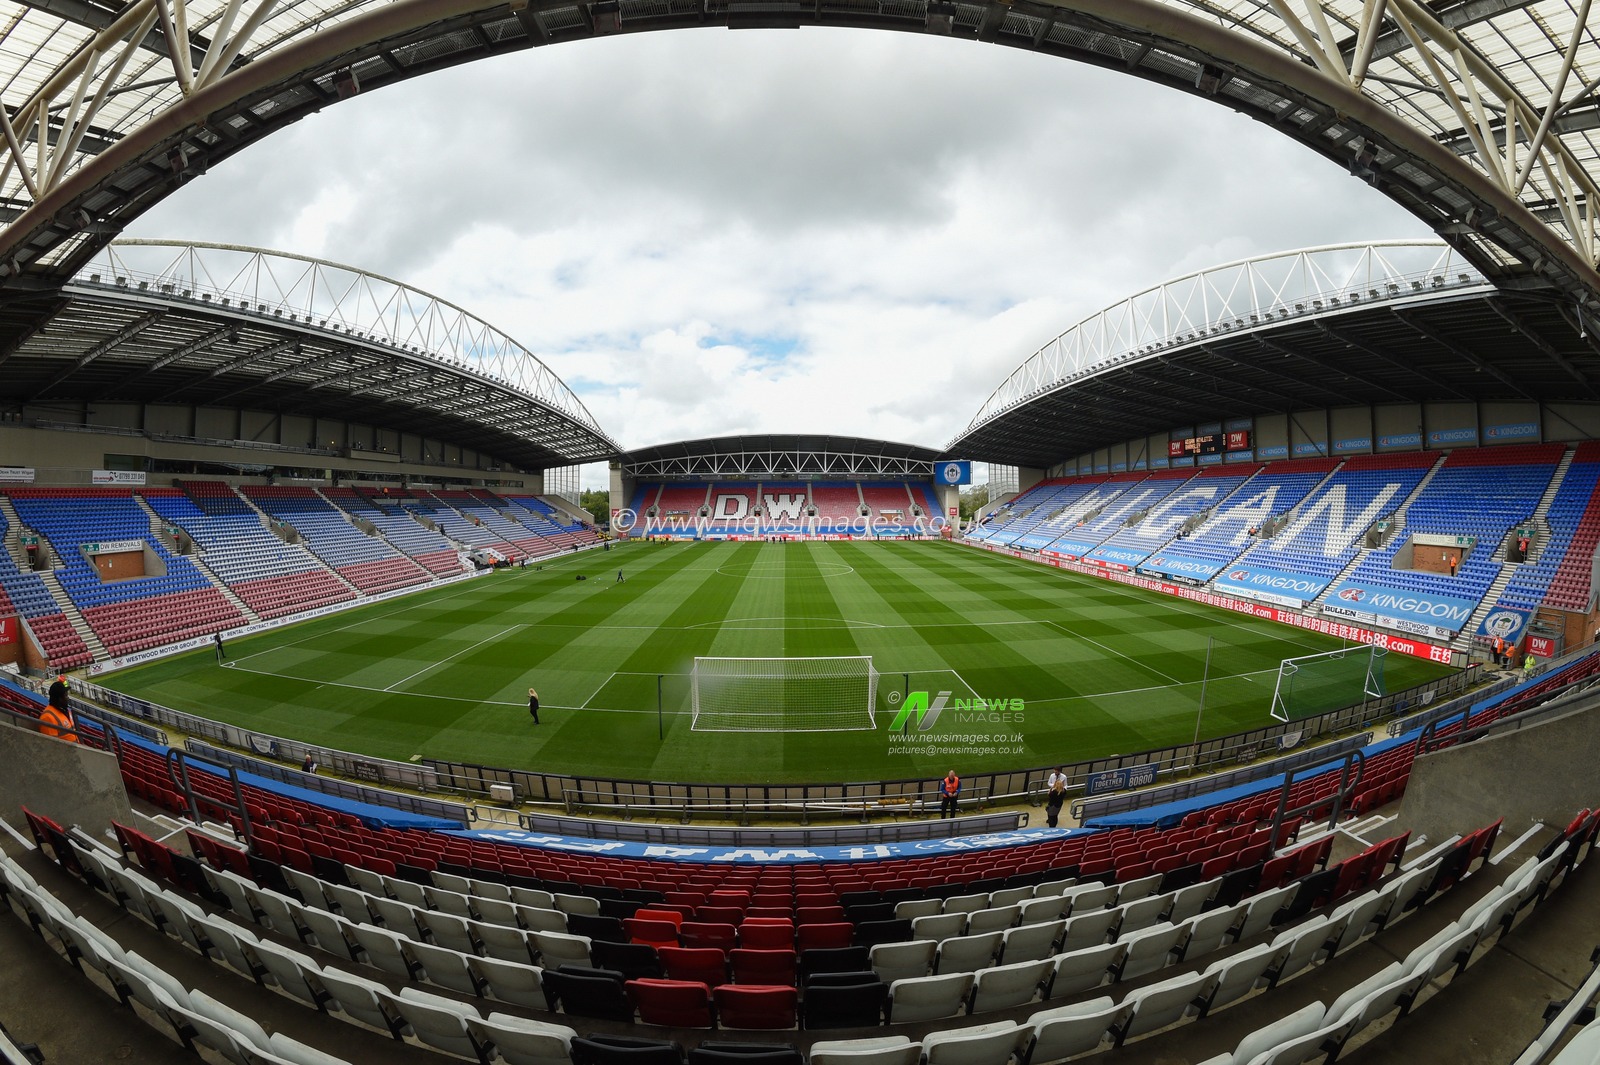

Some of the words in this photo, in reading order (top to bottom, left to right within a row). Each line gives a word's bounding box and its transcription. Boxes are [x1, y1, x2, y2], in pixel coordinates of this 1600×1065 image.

[1443, 430, 1476, 440] KINGDOM
[1501, 424, 1537, 436] KINGDOM
[1231, 433, 1242, 442] DW
[1391, 434, 1420, 444] KINGDOM
[714, 493, 807, 521] DW
[1049, 483, 1401, 558] WIGAN
[111, 540, 141, 549] REMOVALS
[1104, 550, 1147, 563] KINGDOM
[1165, 560, 1219, 575] KINGDOM
[1148, 581, 1175, 595] kb88.com
[1250, 573, 1325, 595] KINGDOM
[1234, 600, 1272, 619] kb88.com
[1324, 605, 1357, 618] BULLEN
[1369, 593, 1472, 622] KINGDOM
[288, 613, 305, 621] FLEXIBLE
[227, 629, 243, 637] RENTAL
[247, 622, 269, 632] CONTRACT
[1397, 620, 1429, 631] WESTWOOD
[1277, 610, 1358, 640] 在线博彩的最佳选择
[1360, 629, 1415, 655] kb88.com
[1532, 637, 1548, 650] DW
[125, 650, 158, 663] WESTWOOD
[159, 645, 179, 657] MOTOR
[179, 640, 198, 652] GROUP
[1095, 777, 1123, 788] TOGETHER
[1128, 773, 1153, 787] 80800
